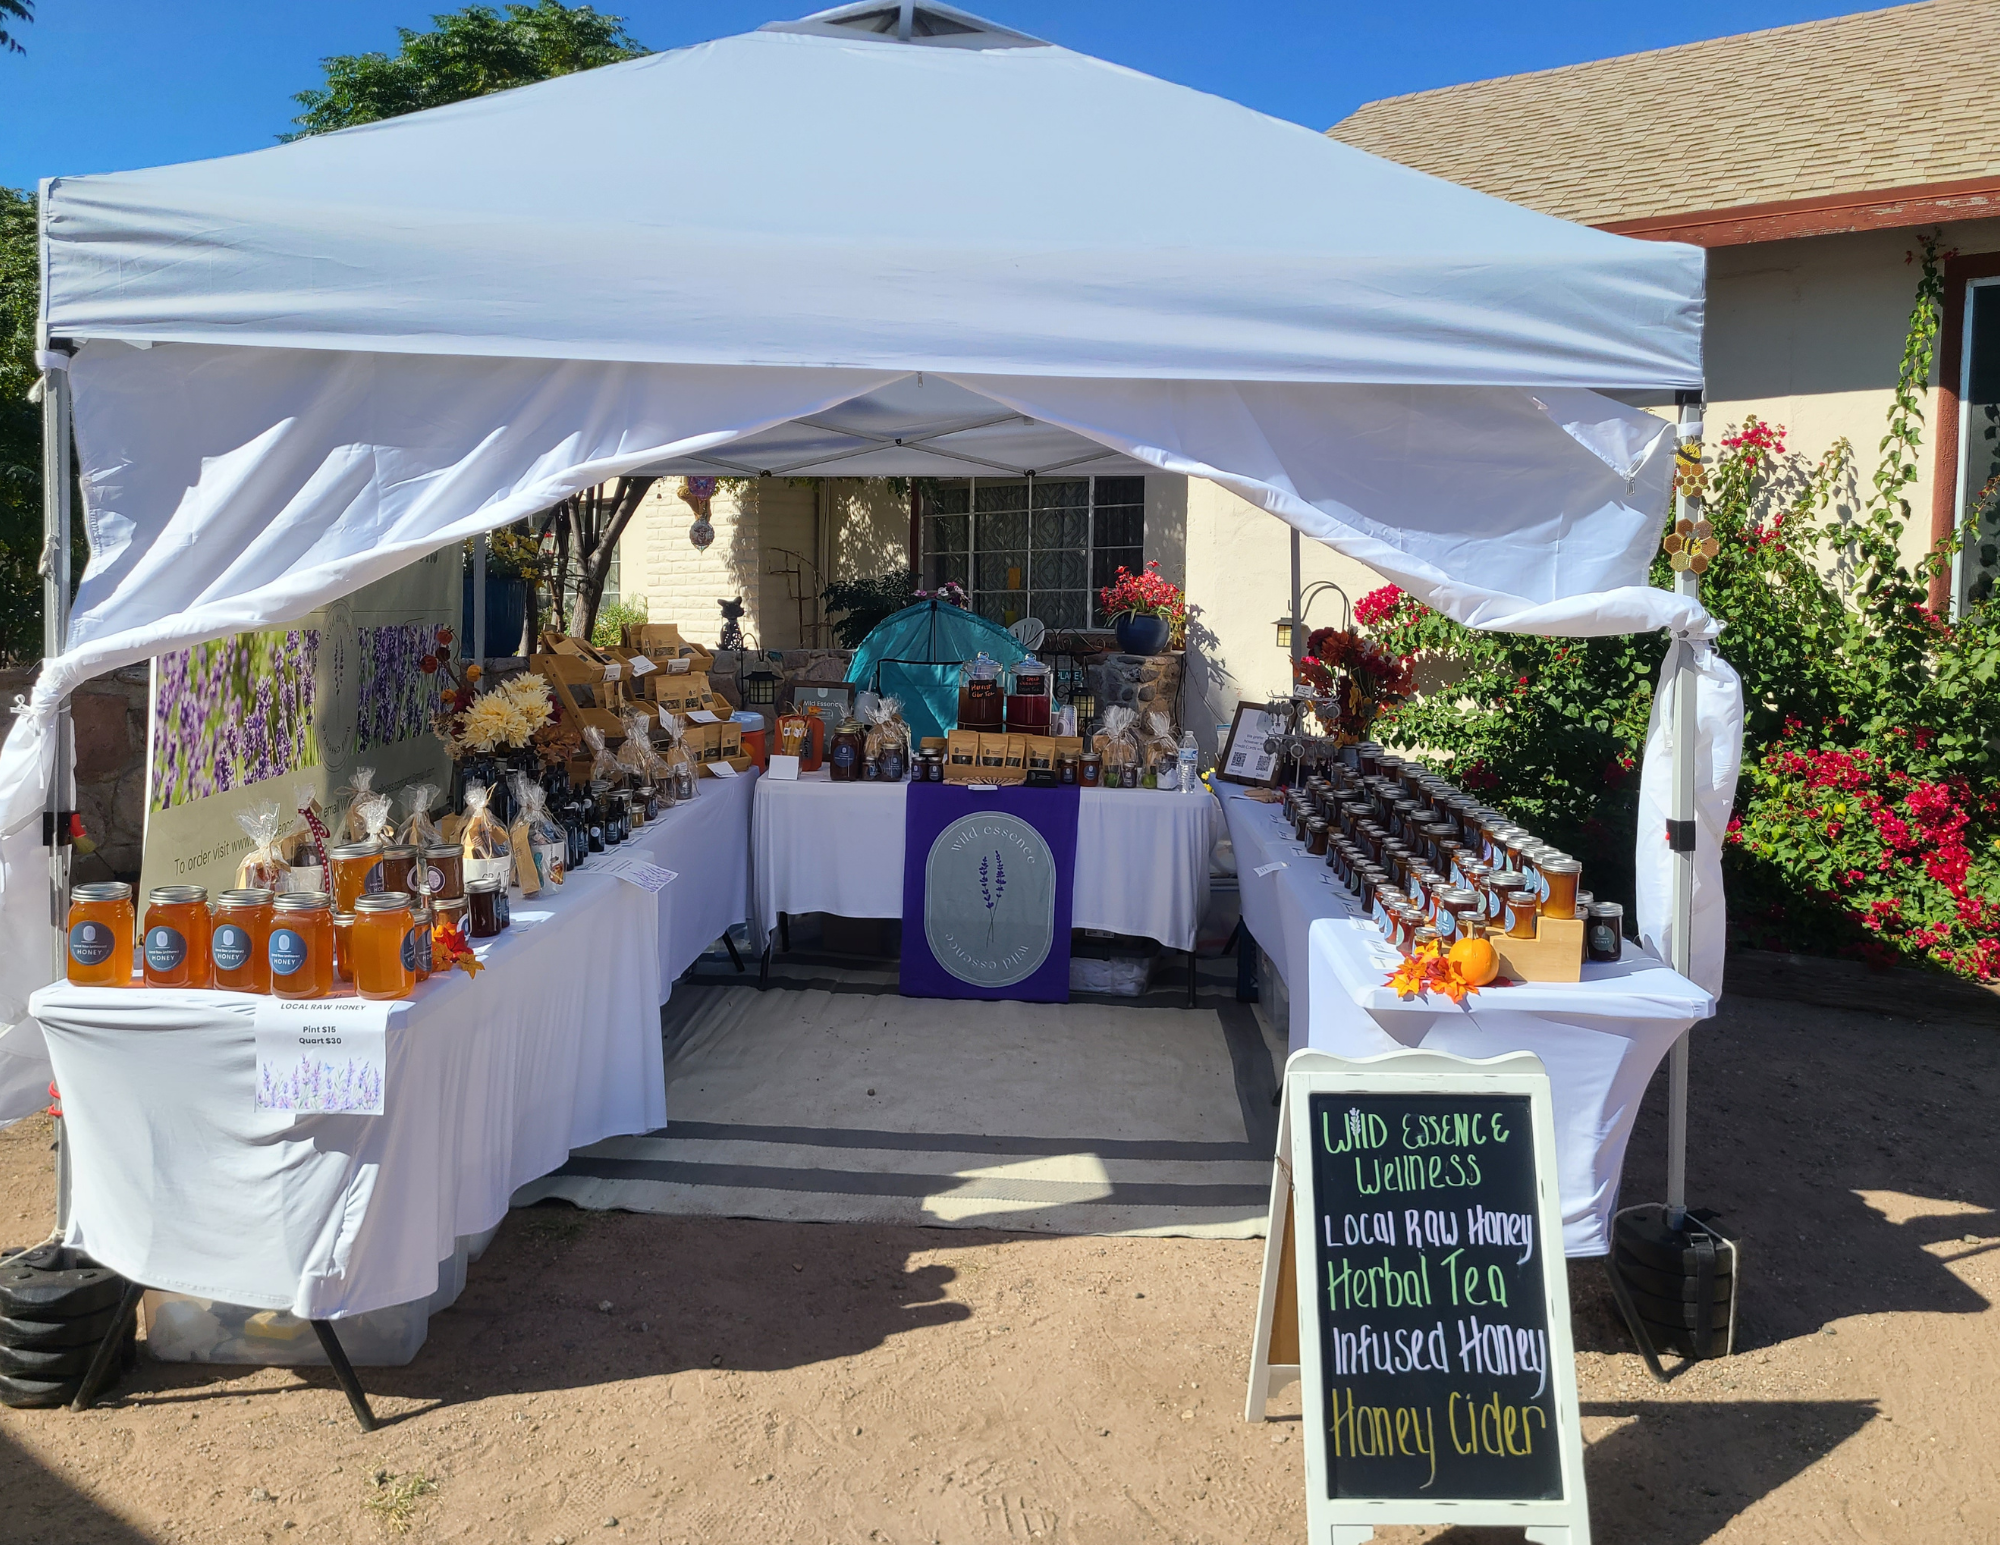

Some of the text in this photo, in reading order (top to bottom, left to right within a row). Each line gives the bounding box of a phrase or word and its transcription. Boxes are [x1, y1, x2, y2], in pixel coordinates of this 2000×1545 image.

[1057, 671, 1080, 681] PLAE
[174, 840, 230, 876] To order visit
[951, 825, 1035, 864] wild essence
[299, 1037, 342, 1045] Quart $30
[303, 1025, 336, 1033] Pint $15
[1467, 1204, 1533, 1265] Honey
[1328, 1248, 1509, 1311] Herbal Tea
[1333, 1315, 1547, 1399] Infused Honey
[1329, 1388, 1547, 1490] Honey Cider
